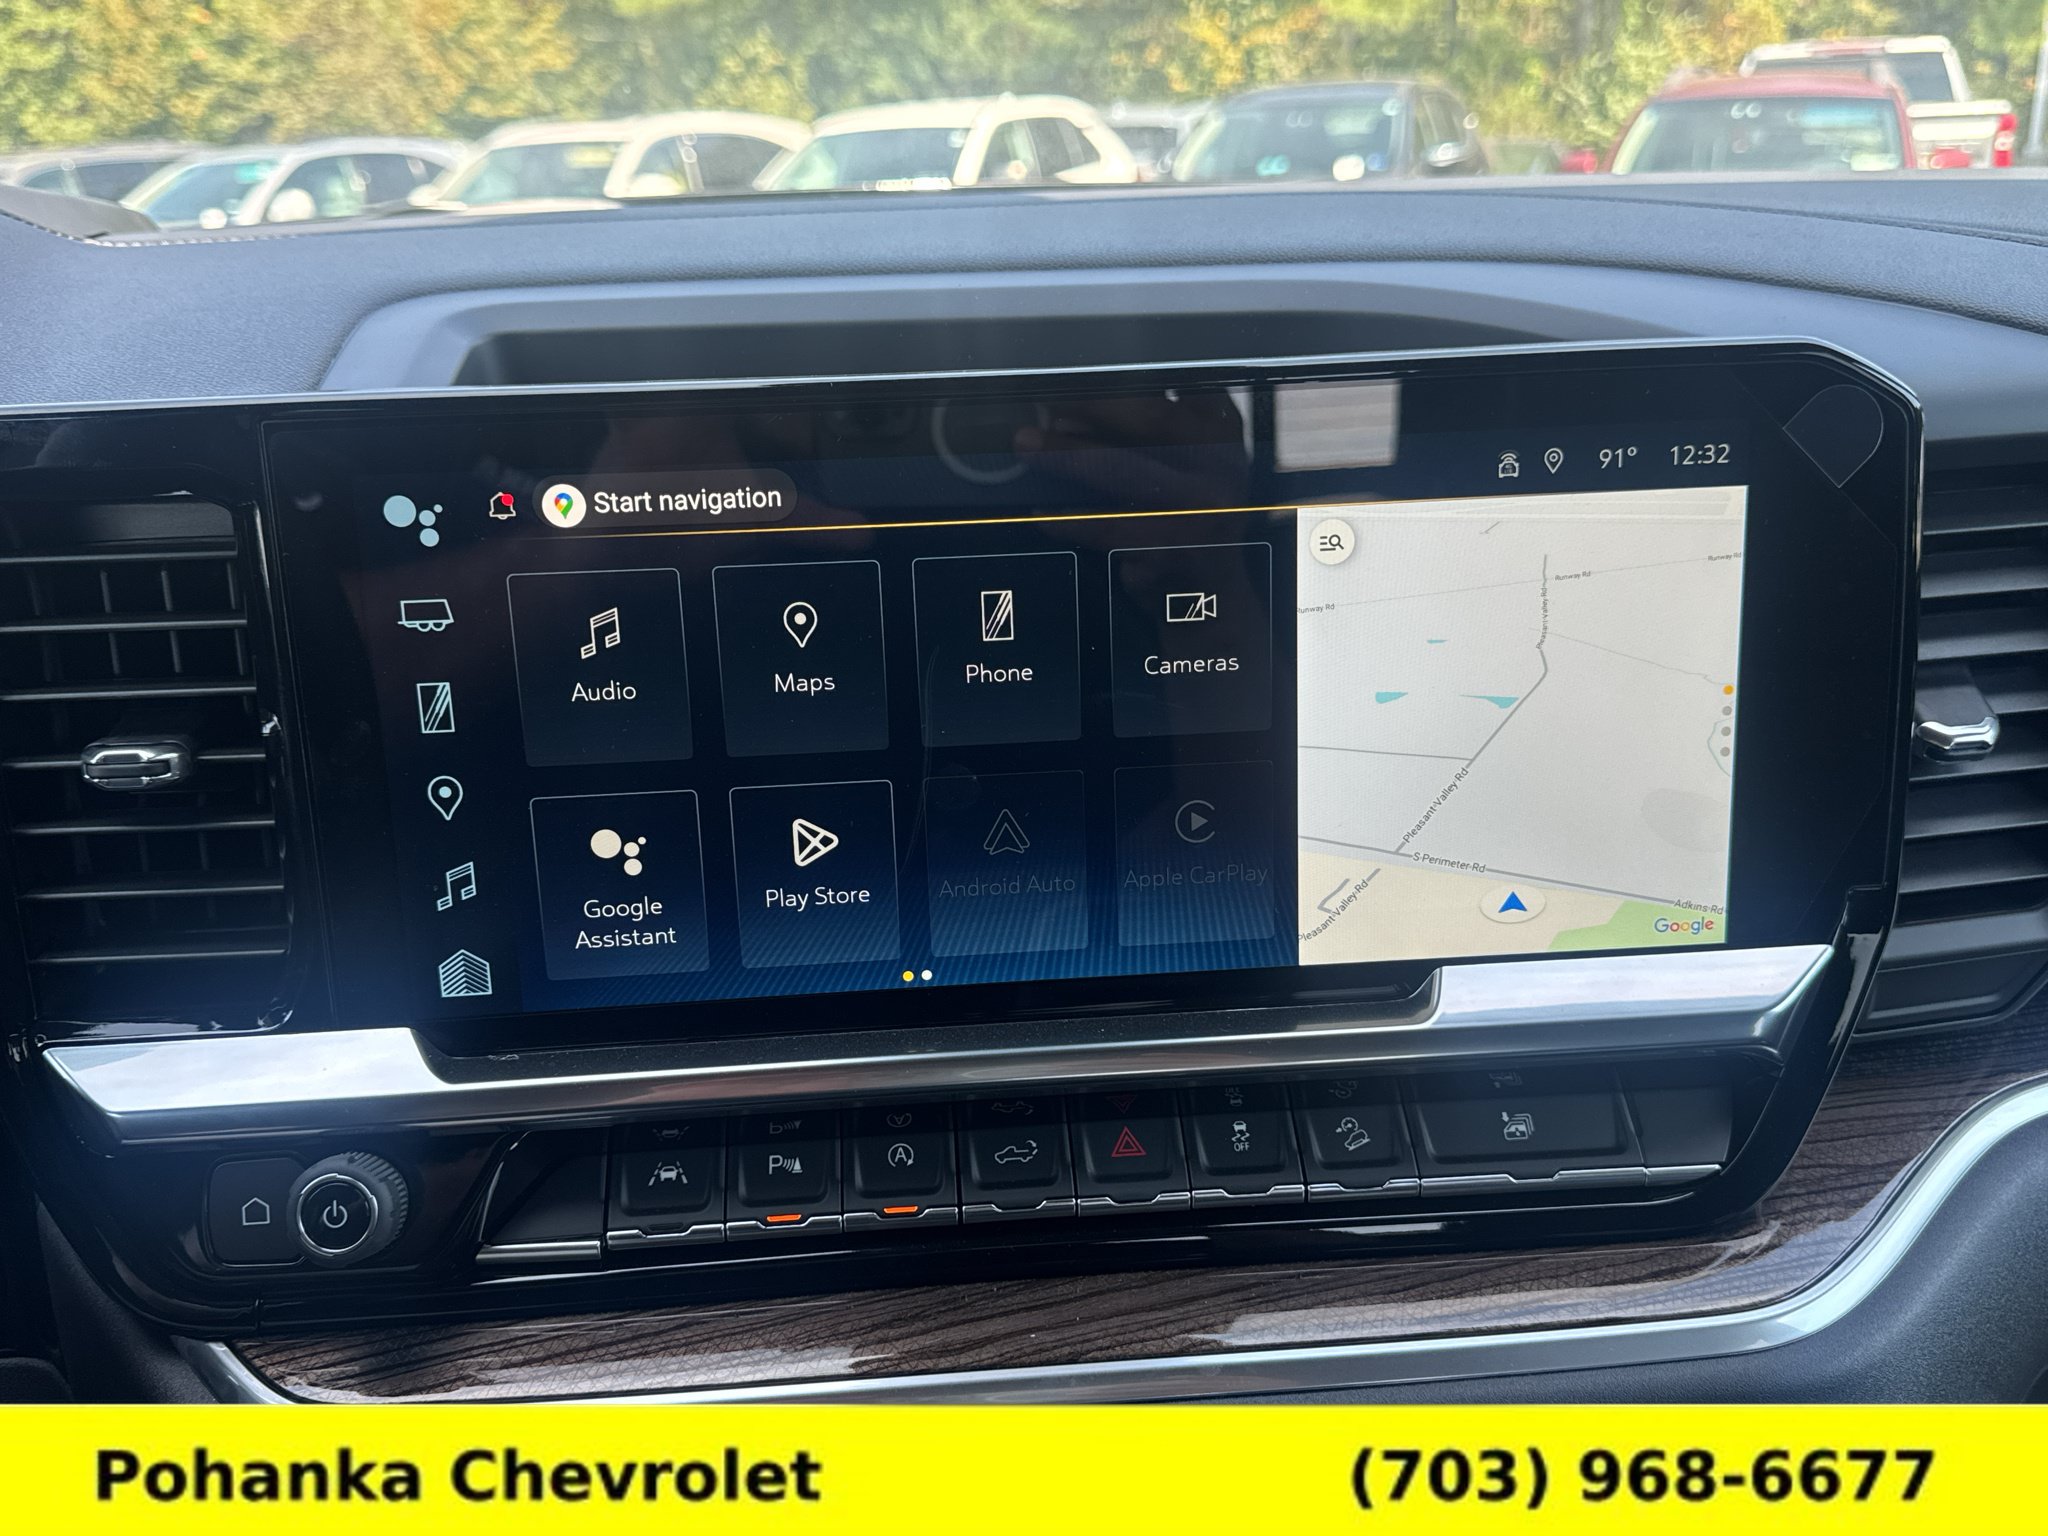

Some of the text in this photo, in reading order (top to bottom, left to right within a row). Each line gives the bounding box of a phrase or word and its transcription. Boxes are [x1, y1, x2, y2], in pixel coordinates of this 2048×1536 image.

[1670, 443, 1731, 466] 12:32
[594, 487, 783, 516] Start navigation
[965, 663, 1034, 684] Phone
[1144, 654, 1240, 676] Cameras
[571, 680, 637, 702] Audio
[774, 672, 836, 696] Maps
[1402, 766, 1470, 844] Pleasant Valley Rd
[1412, 852, 1487, 873] S Perimeter Rd
[938, 874, 1076, 898] Android Auto
[1124, 863, 1268, 892] Apple CarPlay
[583, 896, 663, 921] Google
[765, 886, 871, 912] Play Store
[1331, 891, 1359, 917] Valley
[1354, 878, 1370, 895] Rd
[1674, 898, 1724, 915] Adkins Rd
[1654, 916, 1715, 935] Google
[575, 927, 677, 949] Assistant
[1233, 1141, 1250, 1152] OFF
